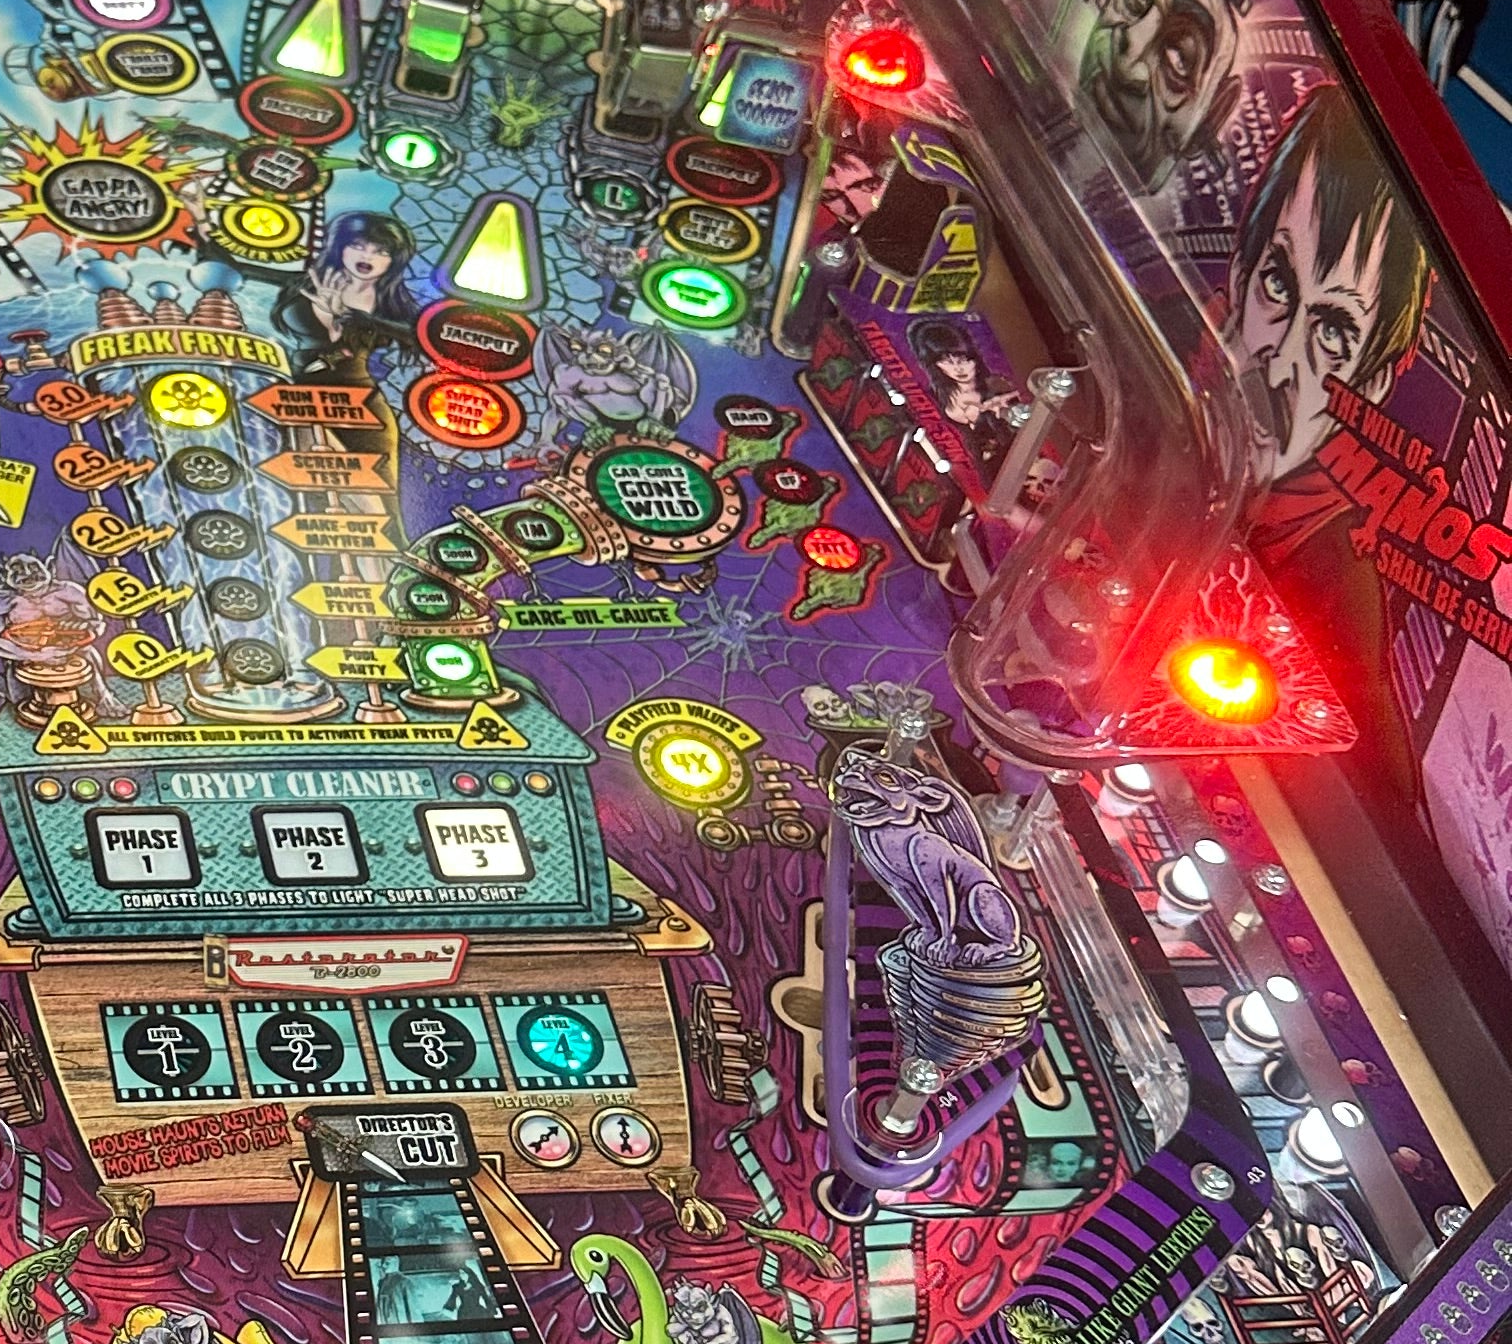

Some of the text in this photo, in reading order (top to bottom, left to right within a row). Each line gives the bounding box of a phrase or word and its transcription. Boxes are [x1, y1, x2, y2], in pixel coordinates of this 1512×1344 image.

[62, 177, 142, 197] GAPPA
[67, 197, 153, 220] ANGRY!
[79, 329, 281, 367] FREAK FRYER
[439, 325, 519, 355] JACKPOT
[39, 384, 87, 413] 3.0
[279, 388, 351, 405] RUN FOR
[323, 404, 365, 420] LIFE!
[1324, 378, 1434, 474] THE WILL OF
[58, 450, 105, 479] 2.5
[293, 455, 362, 471] SCREAM
[311, 471, 352, 486] TEST
[618, 480, 690, 498] GONE
[624, 499, 701, 519] WILD
[1316, 427, 1512, 582] MANOS
[75, 516, 125, 544] 2.0
[296, 519, 379, 536] MAKE-OUT
[519, 523, 549, 541] 1M
[306, 533, 376, 549] MAYHEM
[92, 576, 140, 606] 1.5
[1376, 542, 1434, 604] SHALL
[1433, 581, 1463, 621] BE
[514, 607, 672, 627] GARG-OIL-GAUGE
[112, 638, 159, 670] 1.0
[339, 662, 387, 676] PARTY
[617, 702, 741, 734] PLAYFIELD VALUES
[670, 752, 712, 774] 4X
[170, 769, 426, 801] CRYPT CLEANER
[105, 828, 179, 852] PHASE
[272, 826, 345, 849] PHASE
[436, 824, 510, 846] PHASE
[141, 855, 154, 875] 1
[307, 851, 324, 872] 2
[472, 849, 489, 868] 3
[121, 887, 479, 909] COMPLETE ALL 3 PHASES TO LIGHT HEAD
[148, 1027, 181, 1040] LEVEL
[279, 1024, 313, 1038] LEVEL
[411, 1021, 445, 1035] LEVEL
[541, 1018, 570, 1030] LEVEL
[291, 1034, 317, 1072] 2
[423, 1034, 449, 1066] 3
[551, 1032, 572, 1056] 4
[157, 1040, 179, 1077] 1
[495, 1091, 634, 1107] DEVELOPER FIXER
[939, 1091, 958, 1108] -04
[89, 1102, 288, 1158] HOUSE HAUNTS RETURN
[357, 1113, 453, 1136] DIRECTOR'S
[103, 1124, 292, 1178] MOVIE SPIRITS TO FILM
[399, 1135, 458, 1164] CUT
[1246, 1166, 1266, 1185] -03
[1110, 1205, 1217, 1318] GIANT LEECHES!
